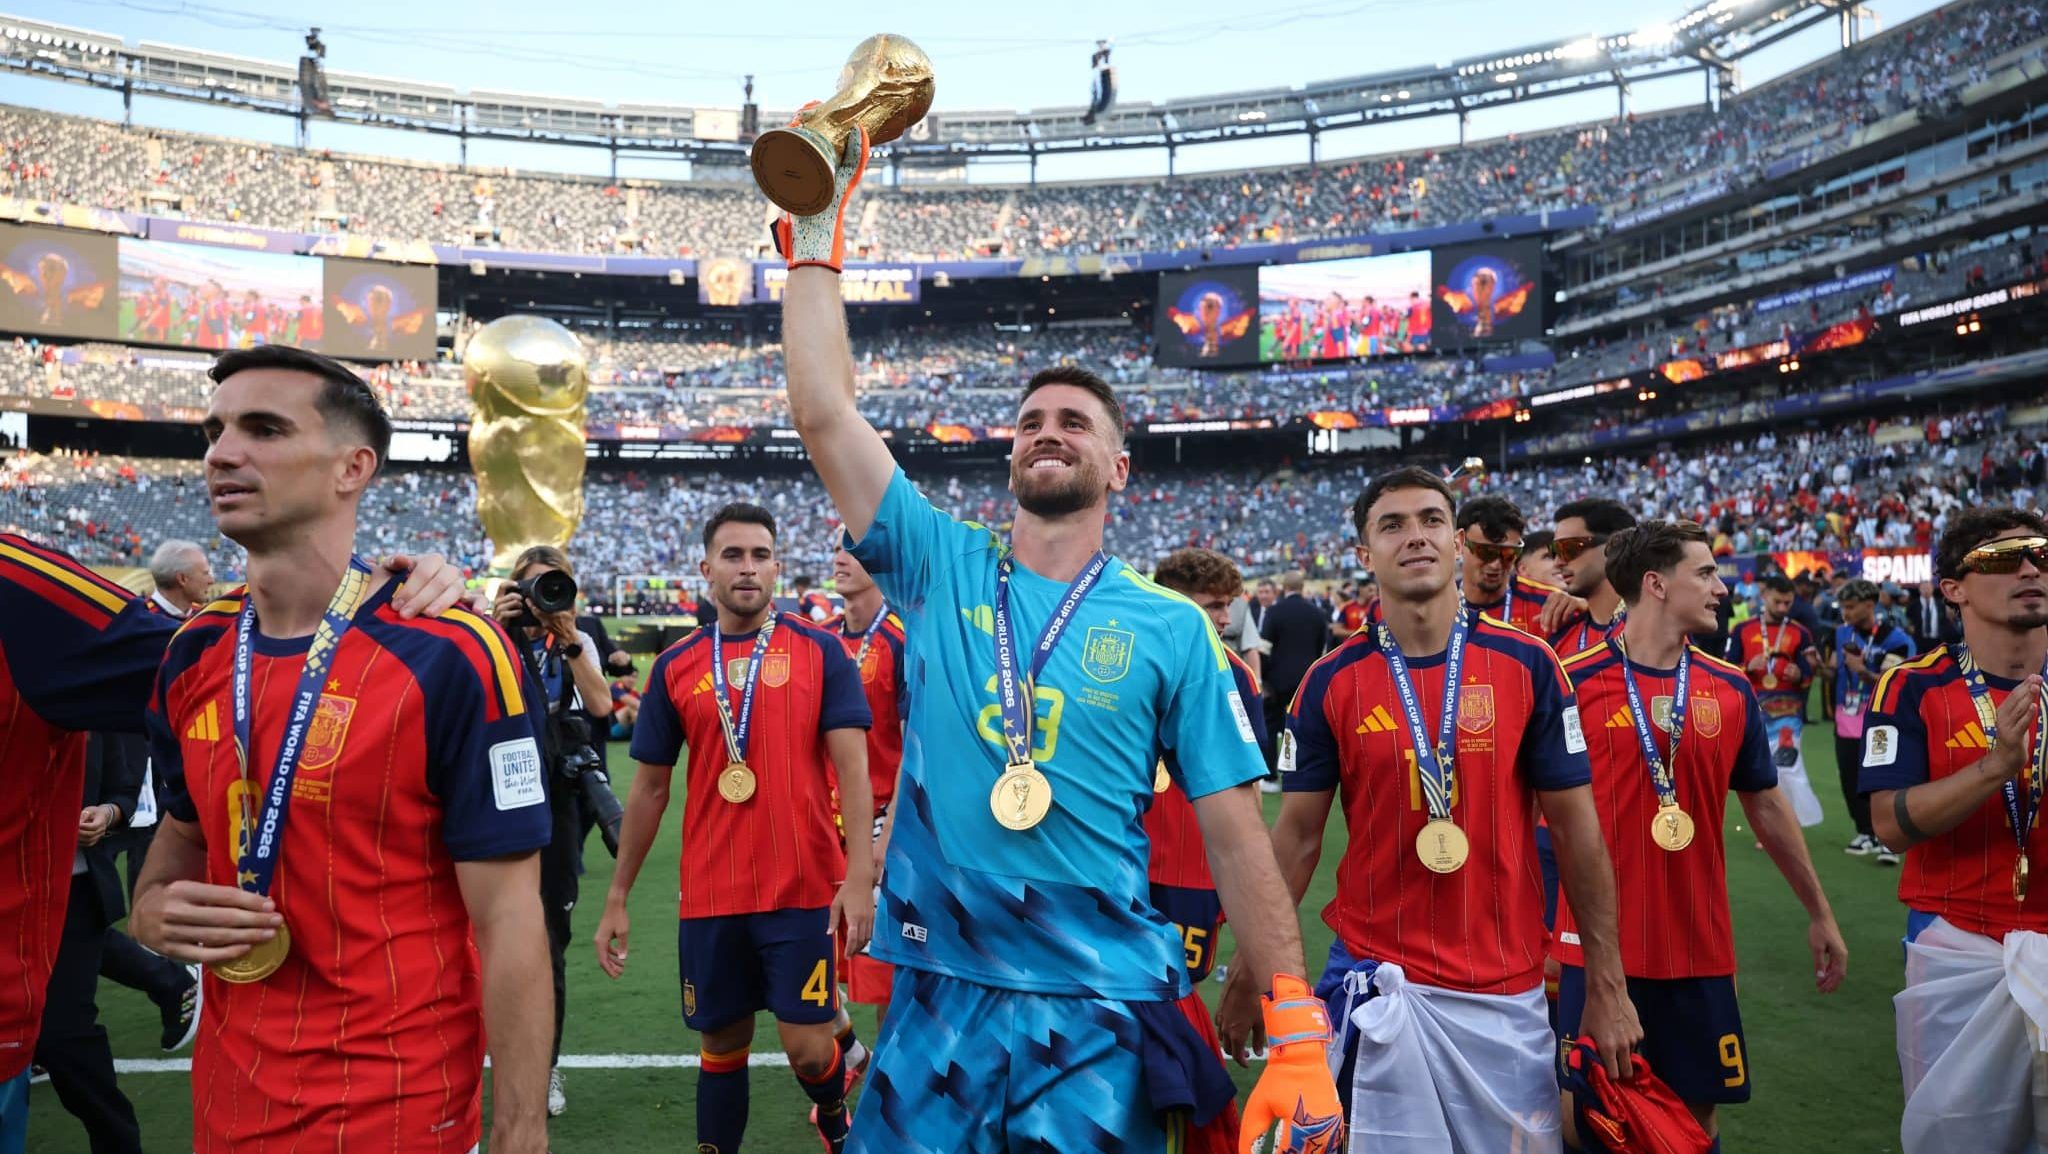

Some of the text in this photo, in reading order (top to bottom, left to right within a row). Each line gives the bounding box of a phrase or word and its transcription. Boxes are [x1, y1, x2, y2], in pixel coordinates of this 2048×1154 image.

[1863, 554, 1931, 583] SPAIN
[1041, 560, 1103, 651] FIFA WORLD CUP 2026
[238, 644, 247, 671] CUP
[996, 610, 1015, 708] WORLD CUP 2026
[236, 673, 246, 722] 2026
[1443, 632, 1462, 734] FIFA WORLD CUP 2026
[1630, 693, 1640, 708] CUP
[1392, 655, 1428, 758] FIFA WORLD CUP 2026
[1635, 708, 1648, 736] WORLD
[257, 691, 313, 859] FIFA WORLD CUP 2026
[502, 750, 534, 762] FOOTBA
[503, 760, 537, 776] UNITE
[2005, 781, 2015, 802] FIFA
[1176, 924, 1206, 968] 5
[801, 959, 828, 1007] 4
[1719, 1033, 1745, 1088] 9
